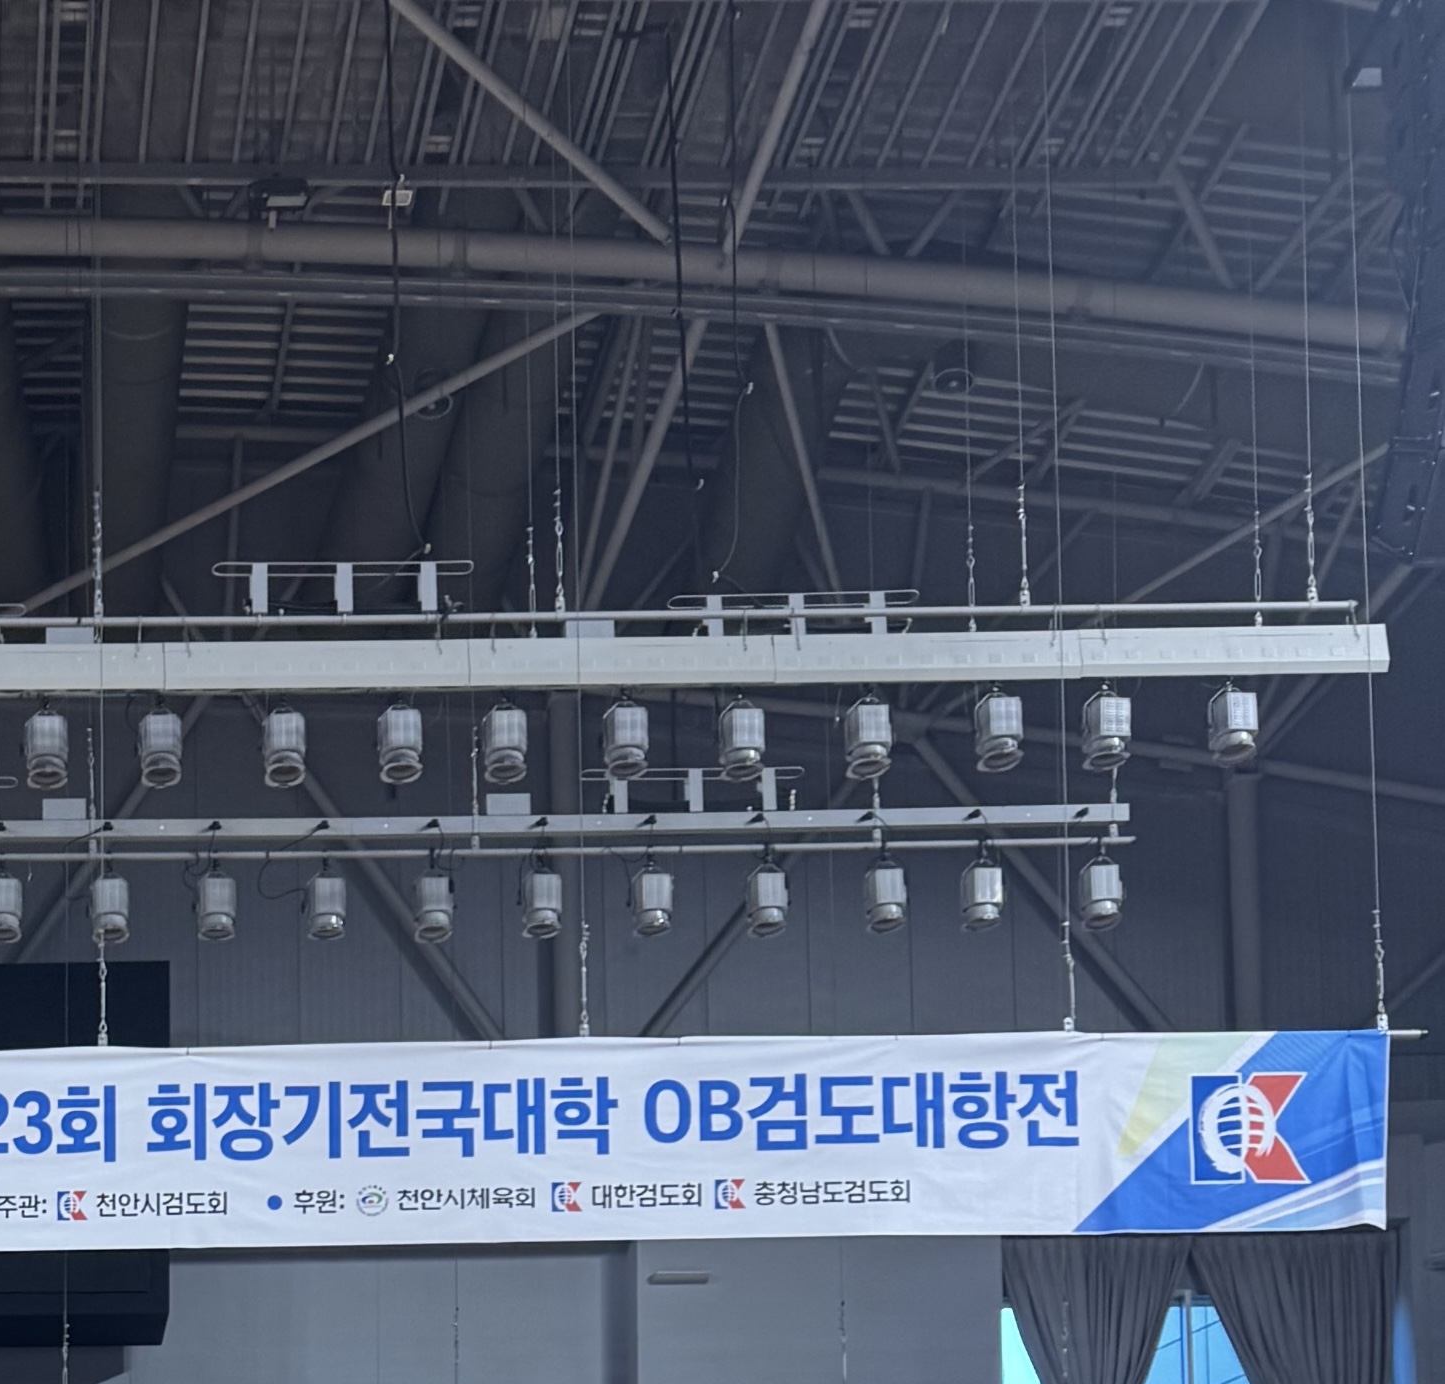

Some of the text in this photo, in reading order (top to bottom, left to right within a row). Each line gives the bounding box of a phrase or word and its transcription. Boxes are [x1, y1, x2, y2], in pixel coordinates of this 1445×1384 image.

[147, 1077, 618, 1160] 회장기전국대학
[645, 1071, 1079, 1151] OB검도대항전
[96, 1191, 228, 1217] 천안시검도회
[294, 1190, 344, 1214] 후원:
[398, 1187, 535, 1210] 천안시체육회
[592, 1183, 702, 1209] 대한검도회
[754, 1179, 911, 1206] 충청남도검도회
